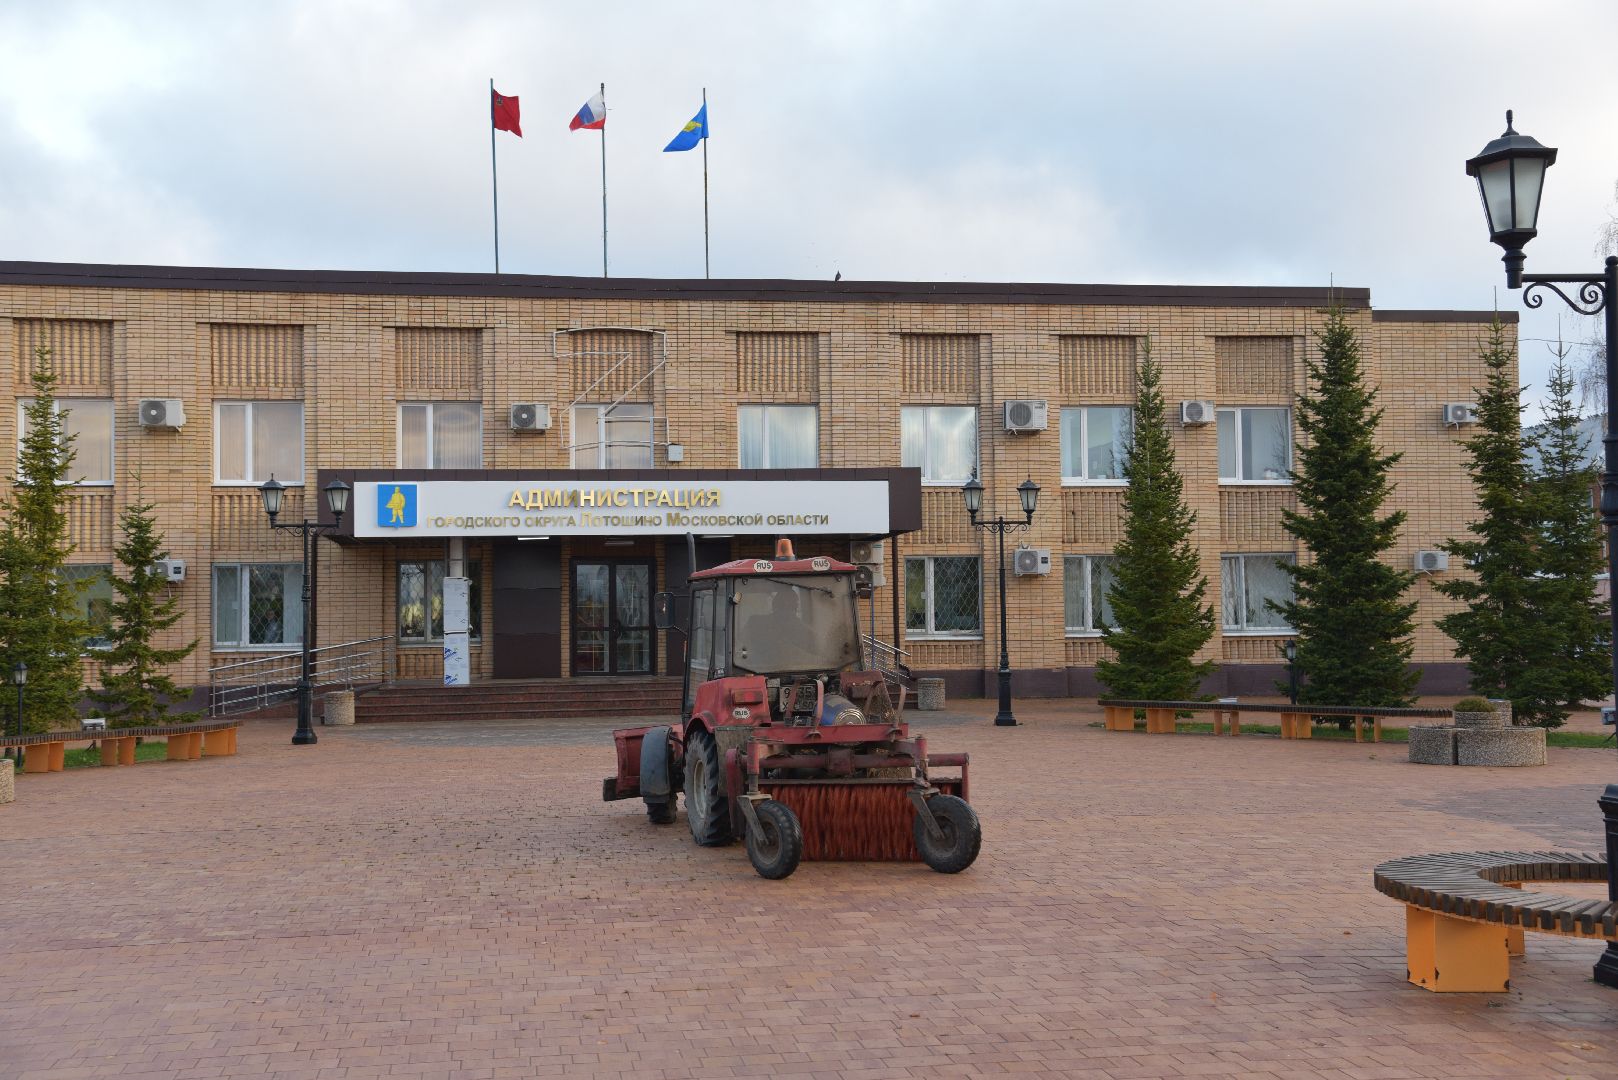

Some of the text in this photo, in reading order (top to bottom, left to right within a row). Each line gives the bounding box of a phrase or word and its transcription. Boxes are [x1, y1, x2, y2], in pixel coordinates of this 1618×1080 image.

[508, 488, 721, 511] АДМИНИСТРАЦИЯ
[427, 515, 520, 529] ГОРОДСКОГО
[524, 515, 576, 528] ОКРУГА
[666, 512, 763, 527] МОСКОВСКОЙ
[767, 514, 829, 526] ОБЛАСТИ
[756, 562, 772, 570] RUS
[814, 559, 829, 568] RUS
